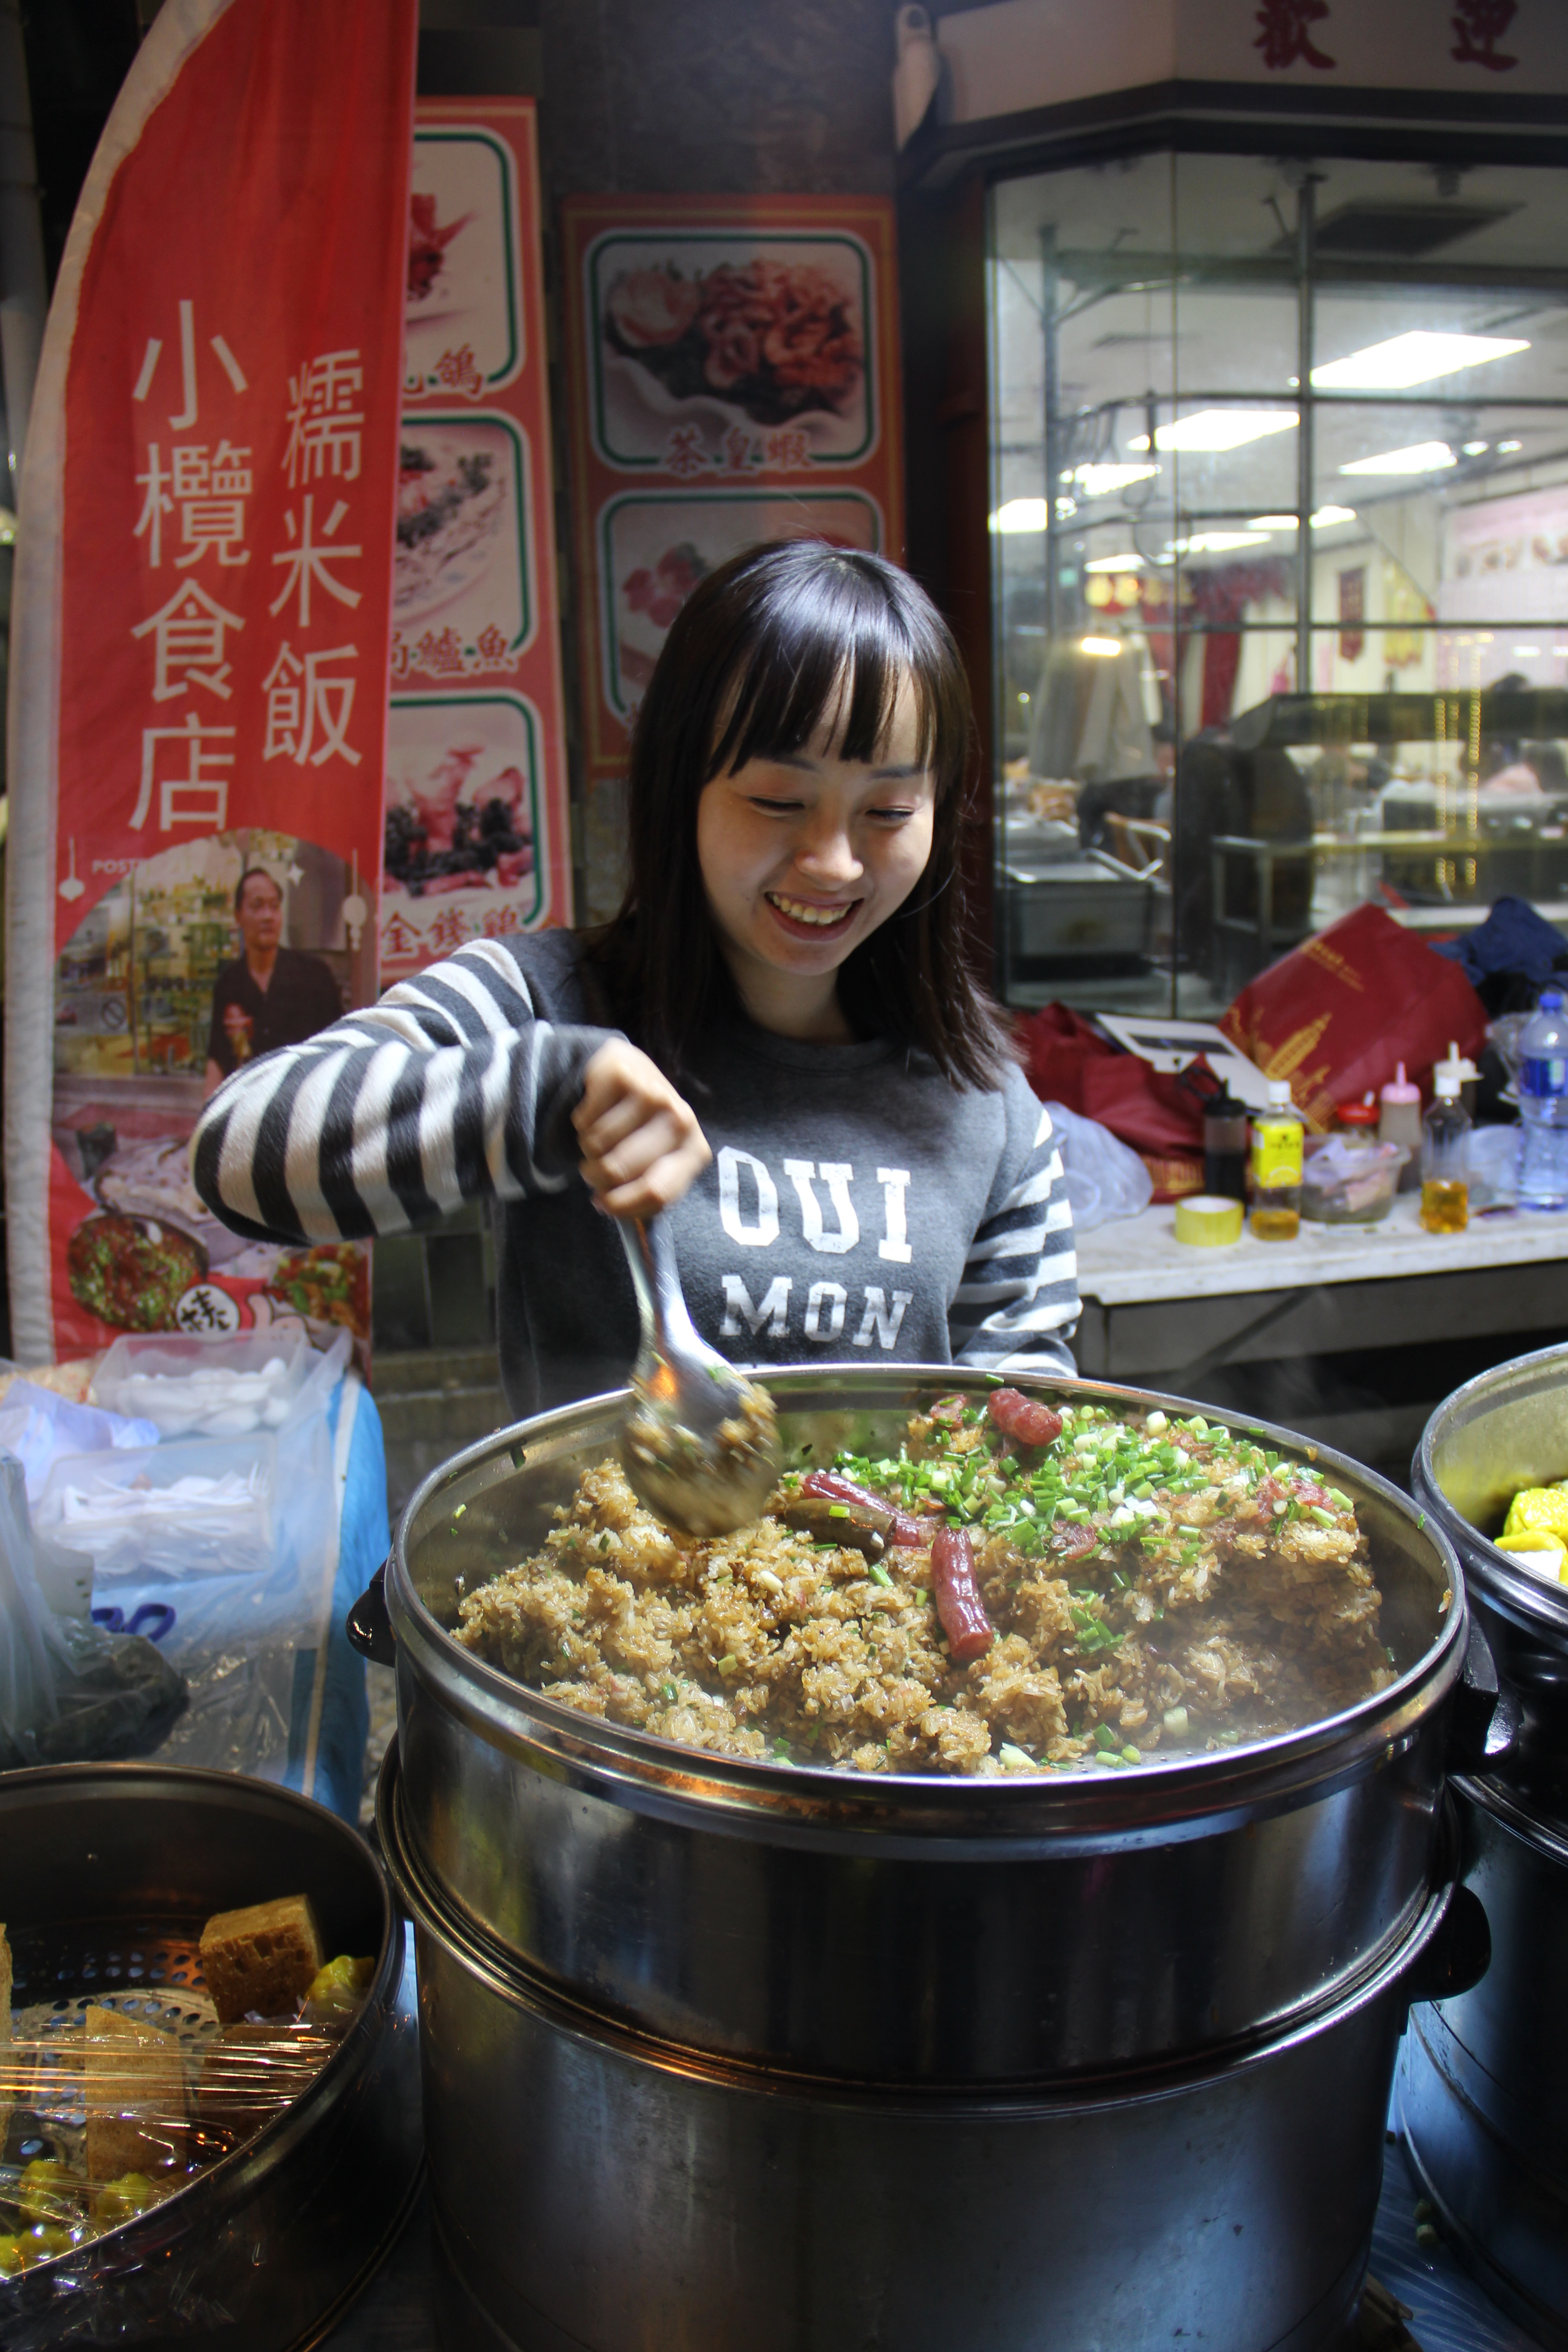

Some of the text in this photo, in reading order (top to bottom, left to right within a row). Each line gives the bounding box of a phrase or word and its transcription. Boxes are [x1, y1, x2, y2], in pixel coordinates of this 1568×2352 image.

[127, 299, 253, 831] 小欖食店
[261, 348, 364, 767] 糯米飯
[717, 1145, 912, 1264] OUI
[719, 1274, 914, 1350] MON
